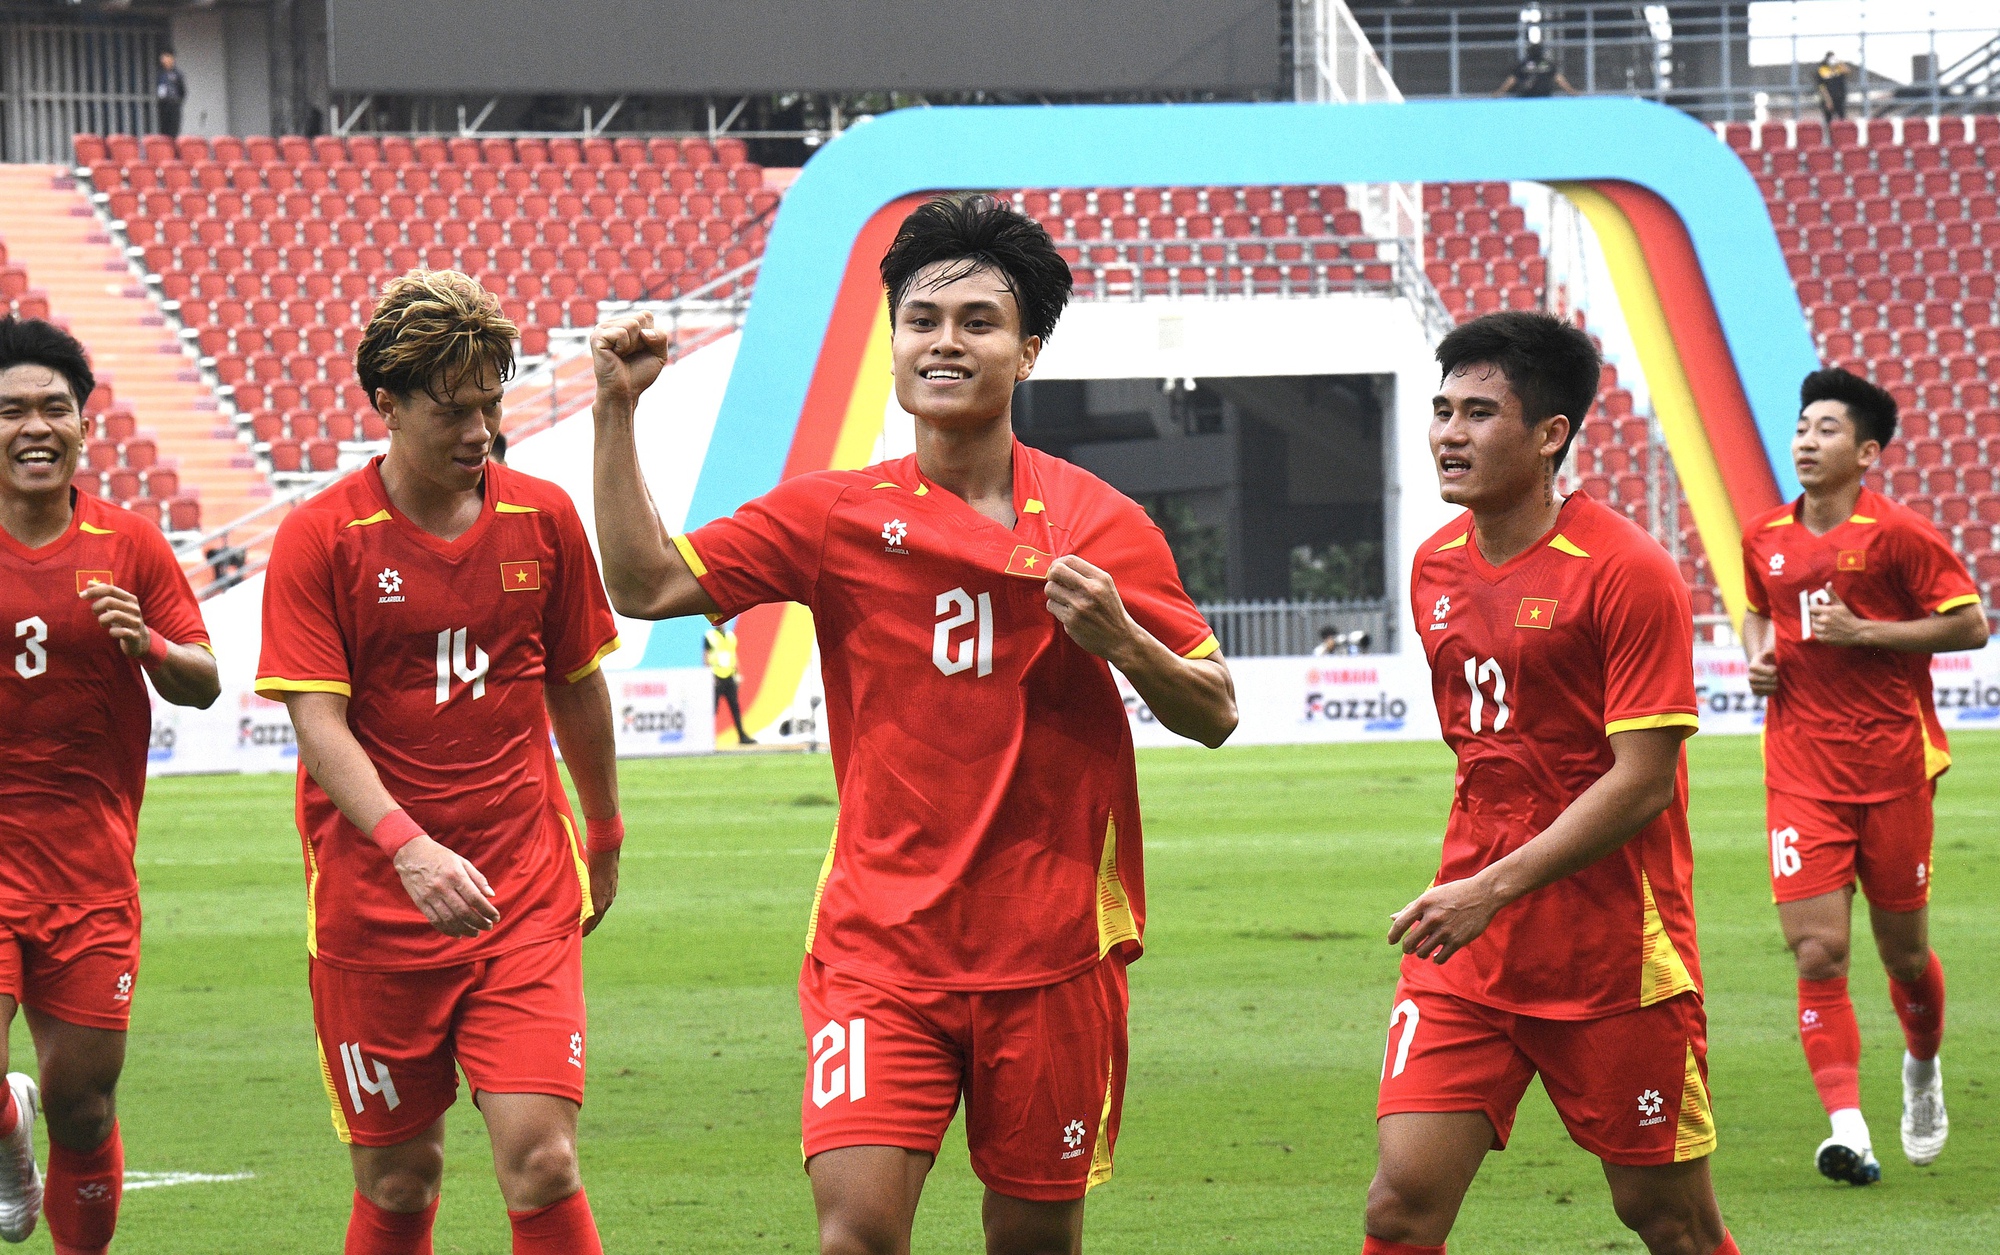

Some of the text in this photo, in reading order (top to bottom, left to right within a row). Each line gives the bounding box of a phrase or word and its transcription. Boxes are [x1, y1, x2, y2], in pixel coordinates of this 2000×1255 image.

[15, 615, 48, 680] 3
[435, 626, 490, 705] 14
[932, 586, 994, 678] 21
[1305, 690, 1407, 721] Fazzio
[1464, 656, 1510, 735] 17
[1770, 825, 1802, 879] 16
[339, 1041, 400, 1115] 14
[811, 1017, 867, 1110] 21
